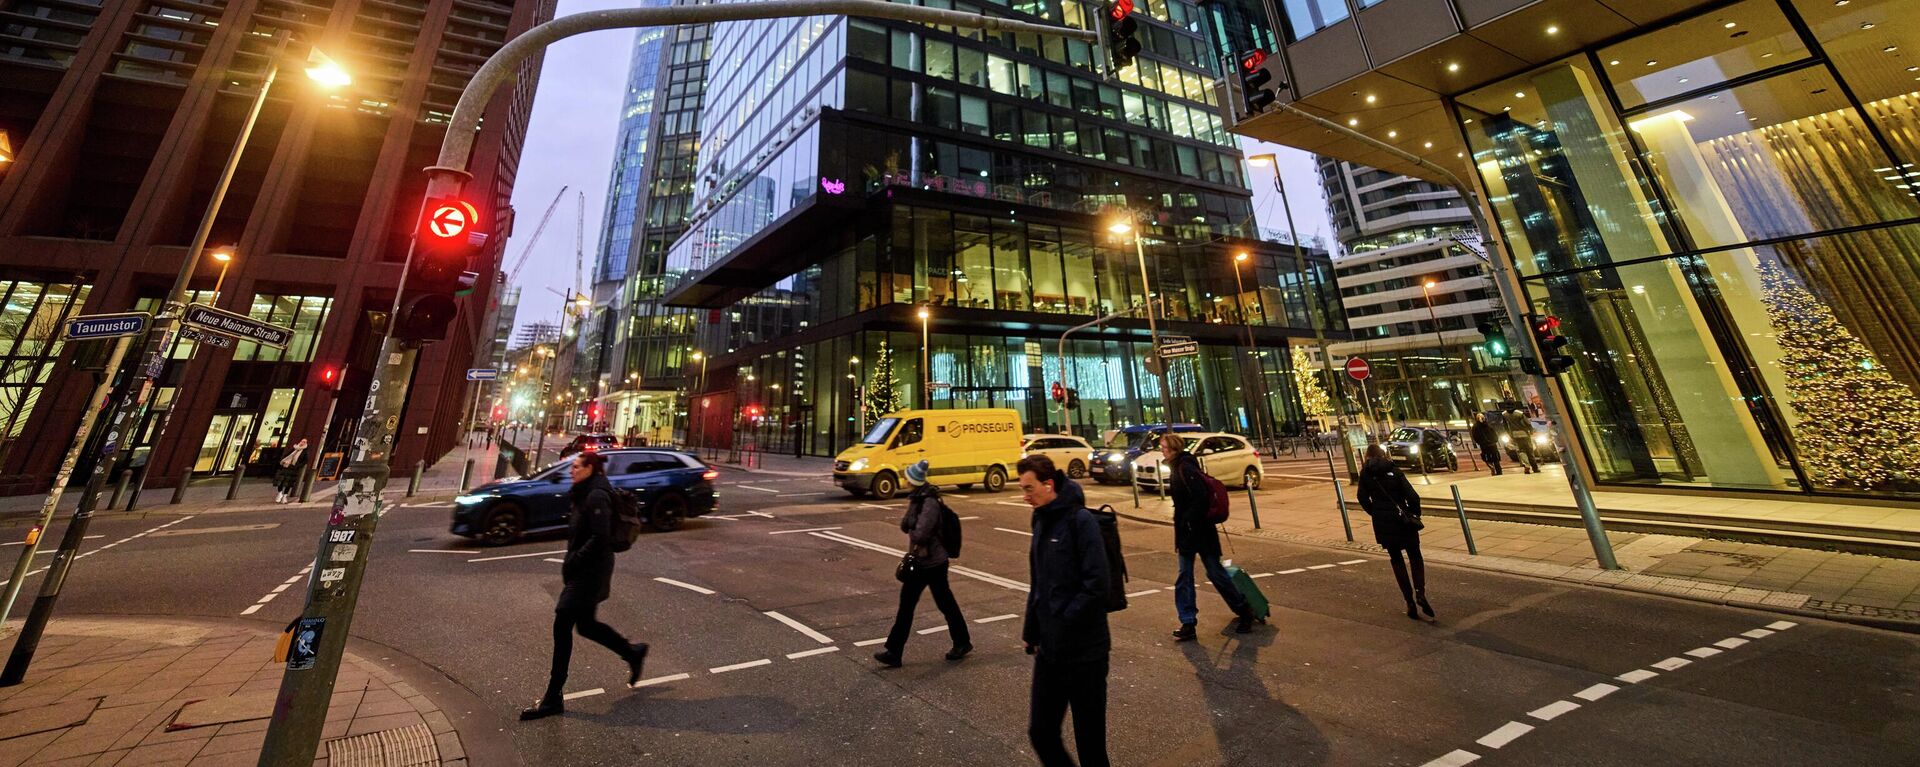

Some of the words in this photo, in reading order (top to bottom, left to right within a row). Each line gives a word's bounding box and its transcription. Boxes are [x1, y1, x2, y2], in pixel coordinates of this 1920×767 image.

[76, 319, 137, 334] Taunustor
[196, 311, 220, 326] Neue
[220, 316, 254, 334] Mainzer
[254, 326, 281, 342] Straße
[181, 329, 204, 341] 37-29
[206, 335, 230, 347] 36-28
[962, 422, 1015, 434] PROSEGUR
[329, 530, 355, 541] 1907
